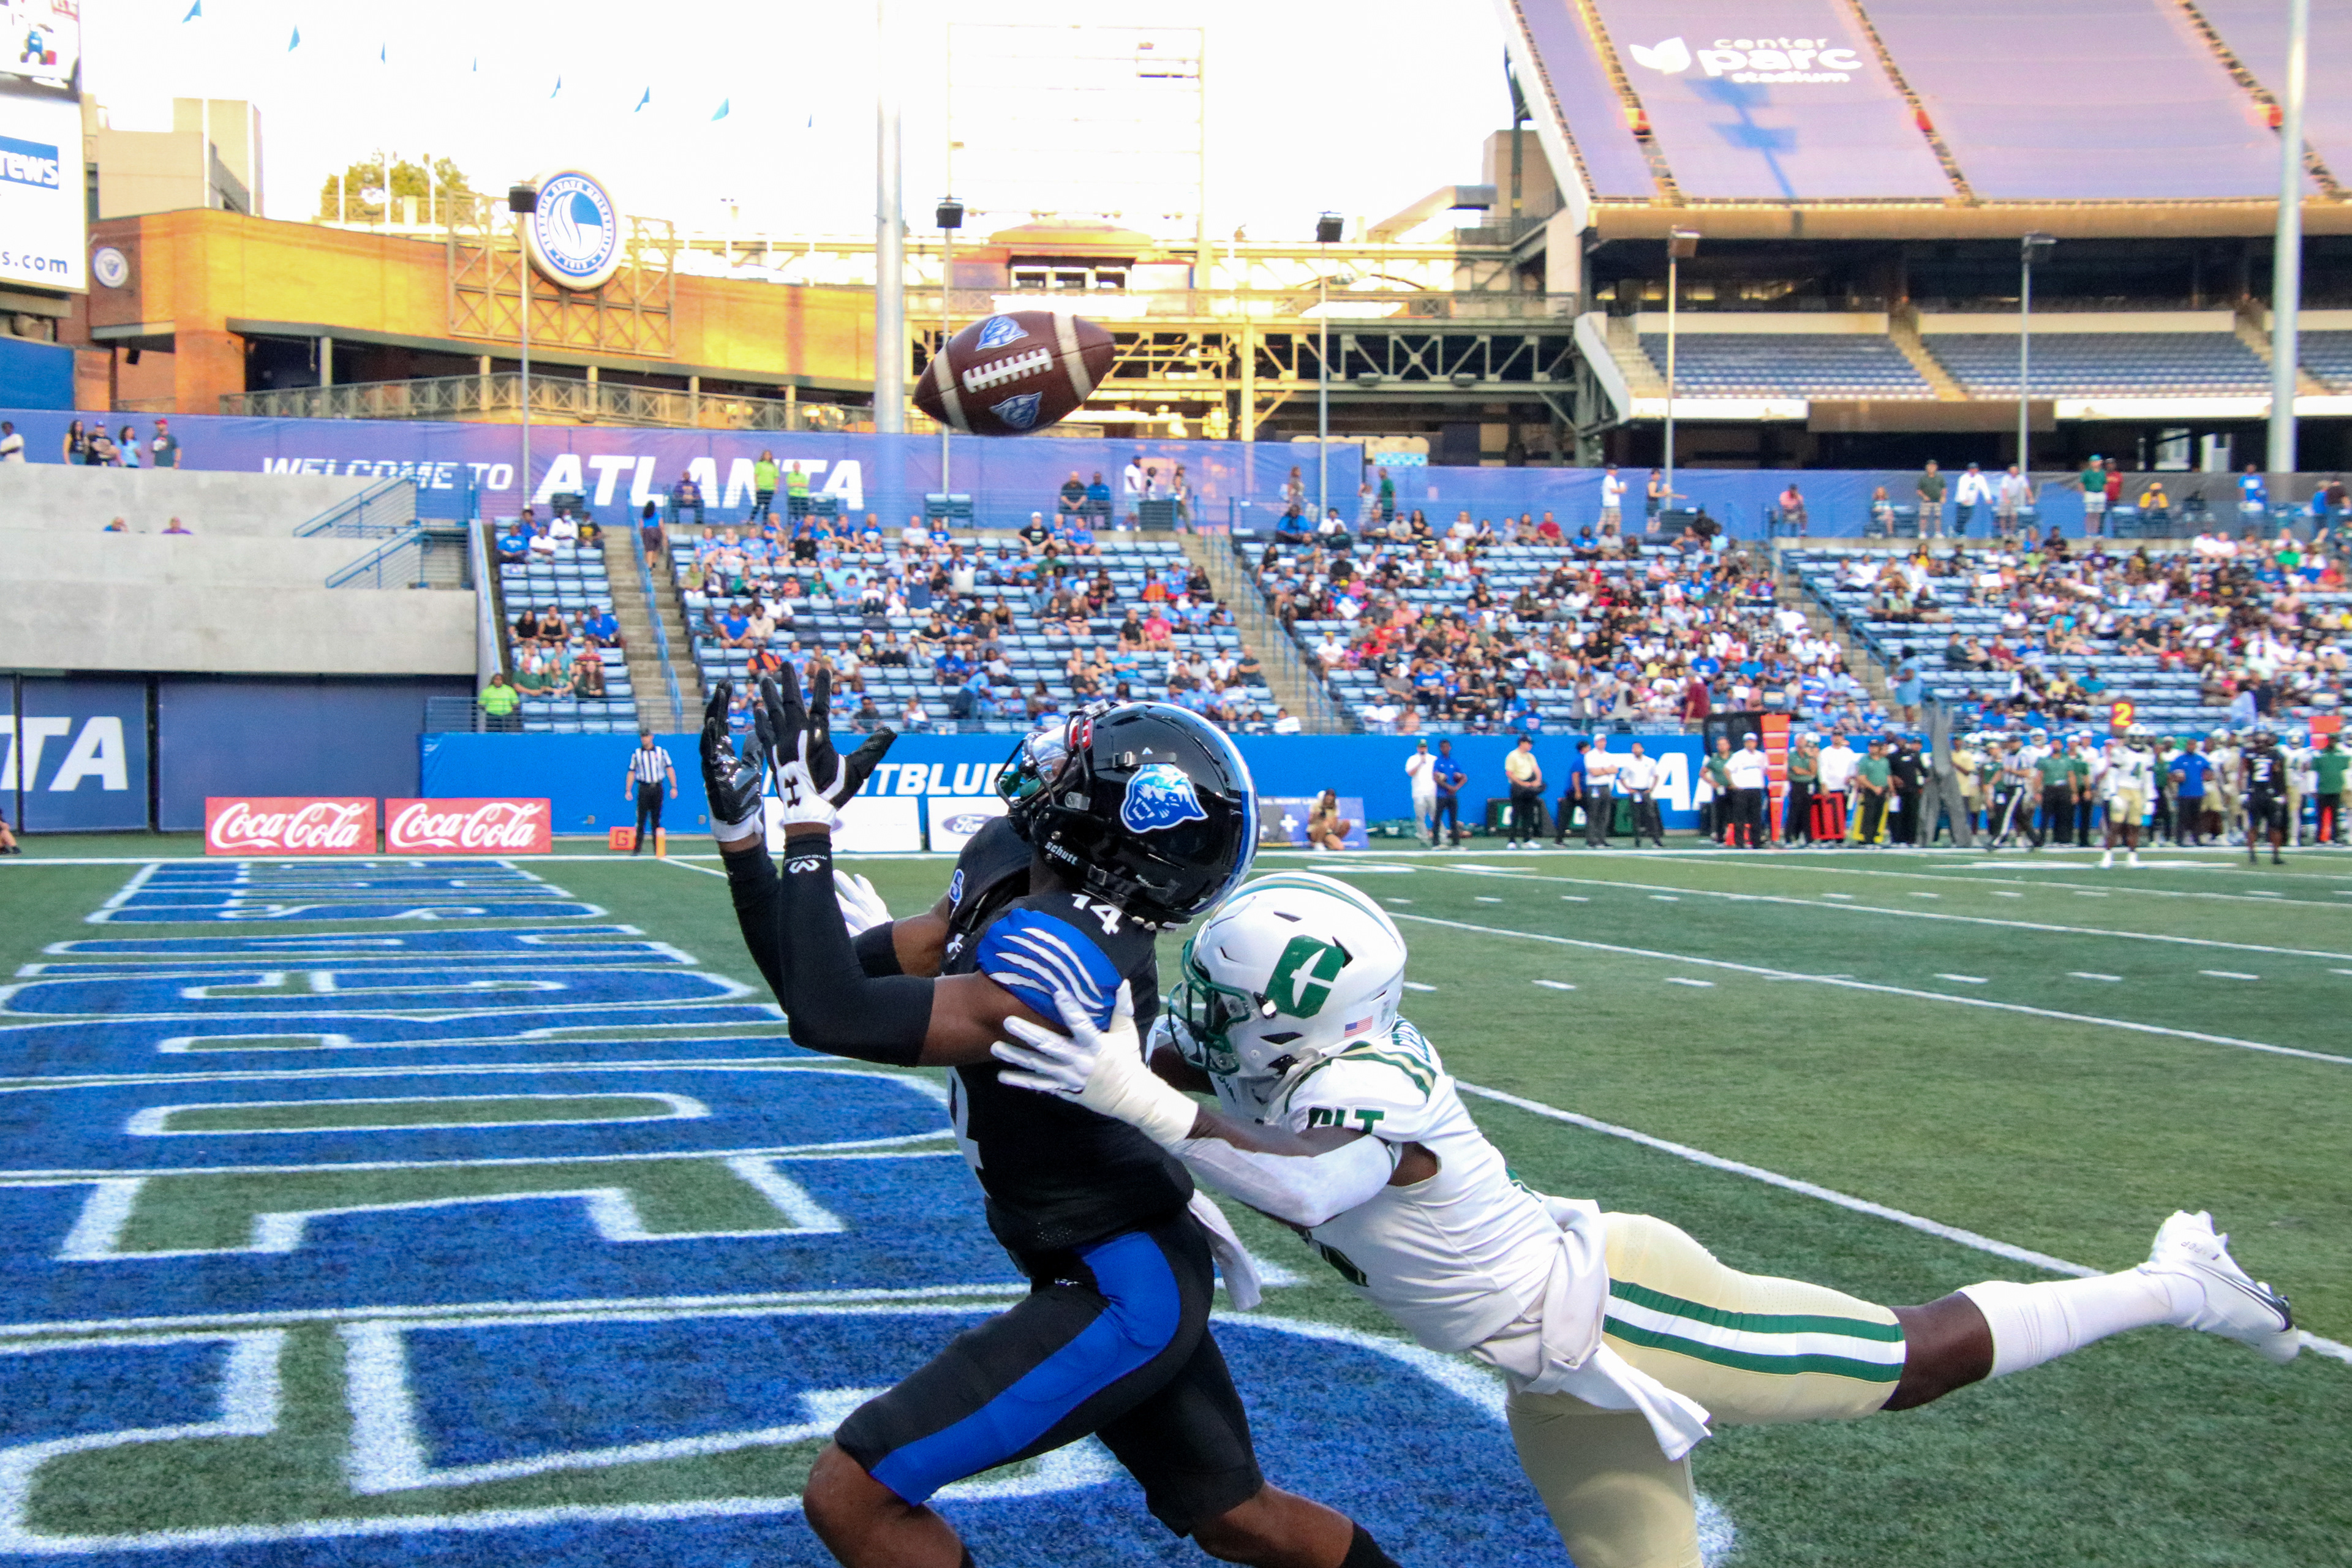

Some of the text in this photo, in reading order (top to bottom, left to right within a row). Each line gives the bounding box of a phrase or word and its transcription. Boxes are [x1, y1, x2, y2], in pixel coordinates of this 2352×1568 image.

[1714, 37, 1828, 50] center
[1697, 48, 1863, 77] parc
[2, 251, 67, 274] s.com
[467, 462, 513, 490] TO
[531, 453, 865, 510] ATLANTA
[2113, 702, 2132, 726] 2
[210, 802, 371, 849] Coca-Cola
[390, 802, 544, 849] Coca-Cola
[1044, 842, 1078, 865] schutt
[1072, 893, 1122, 935] 14
